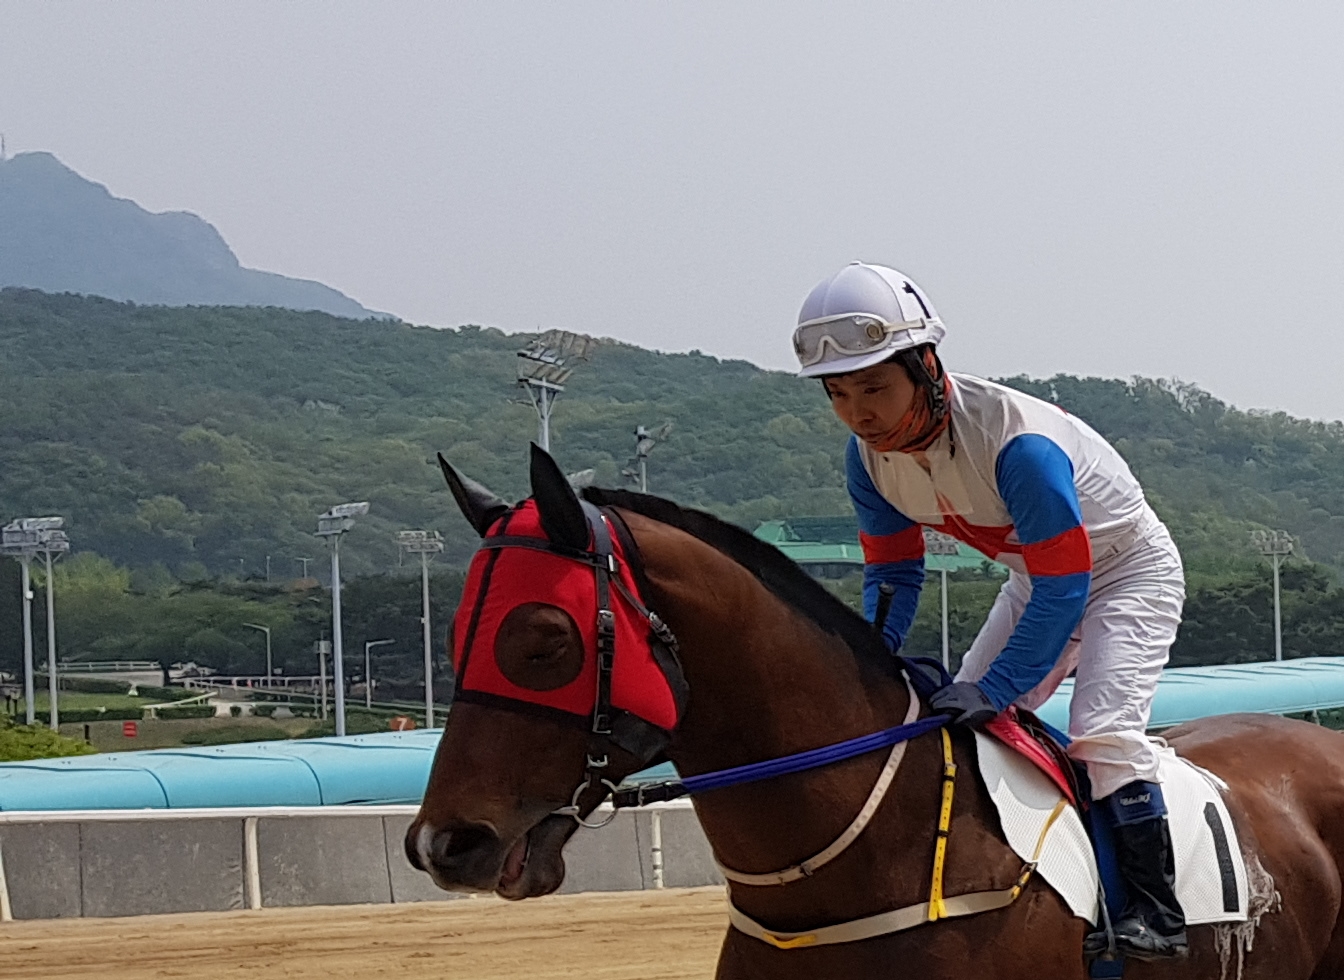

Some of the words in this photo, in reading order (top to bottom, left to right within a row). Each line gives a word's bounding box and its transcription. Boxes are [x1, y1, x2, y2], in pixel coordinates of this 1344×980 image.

[901, 281, 932, 319] 1
[397, 718, 408, 731] 7
[1202, 801, 1240, 913] 1
